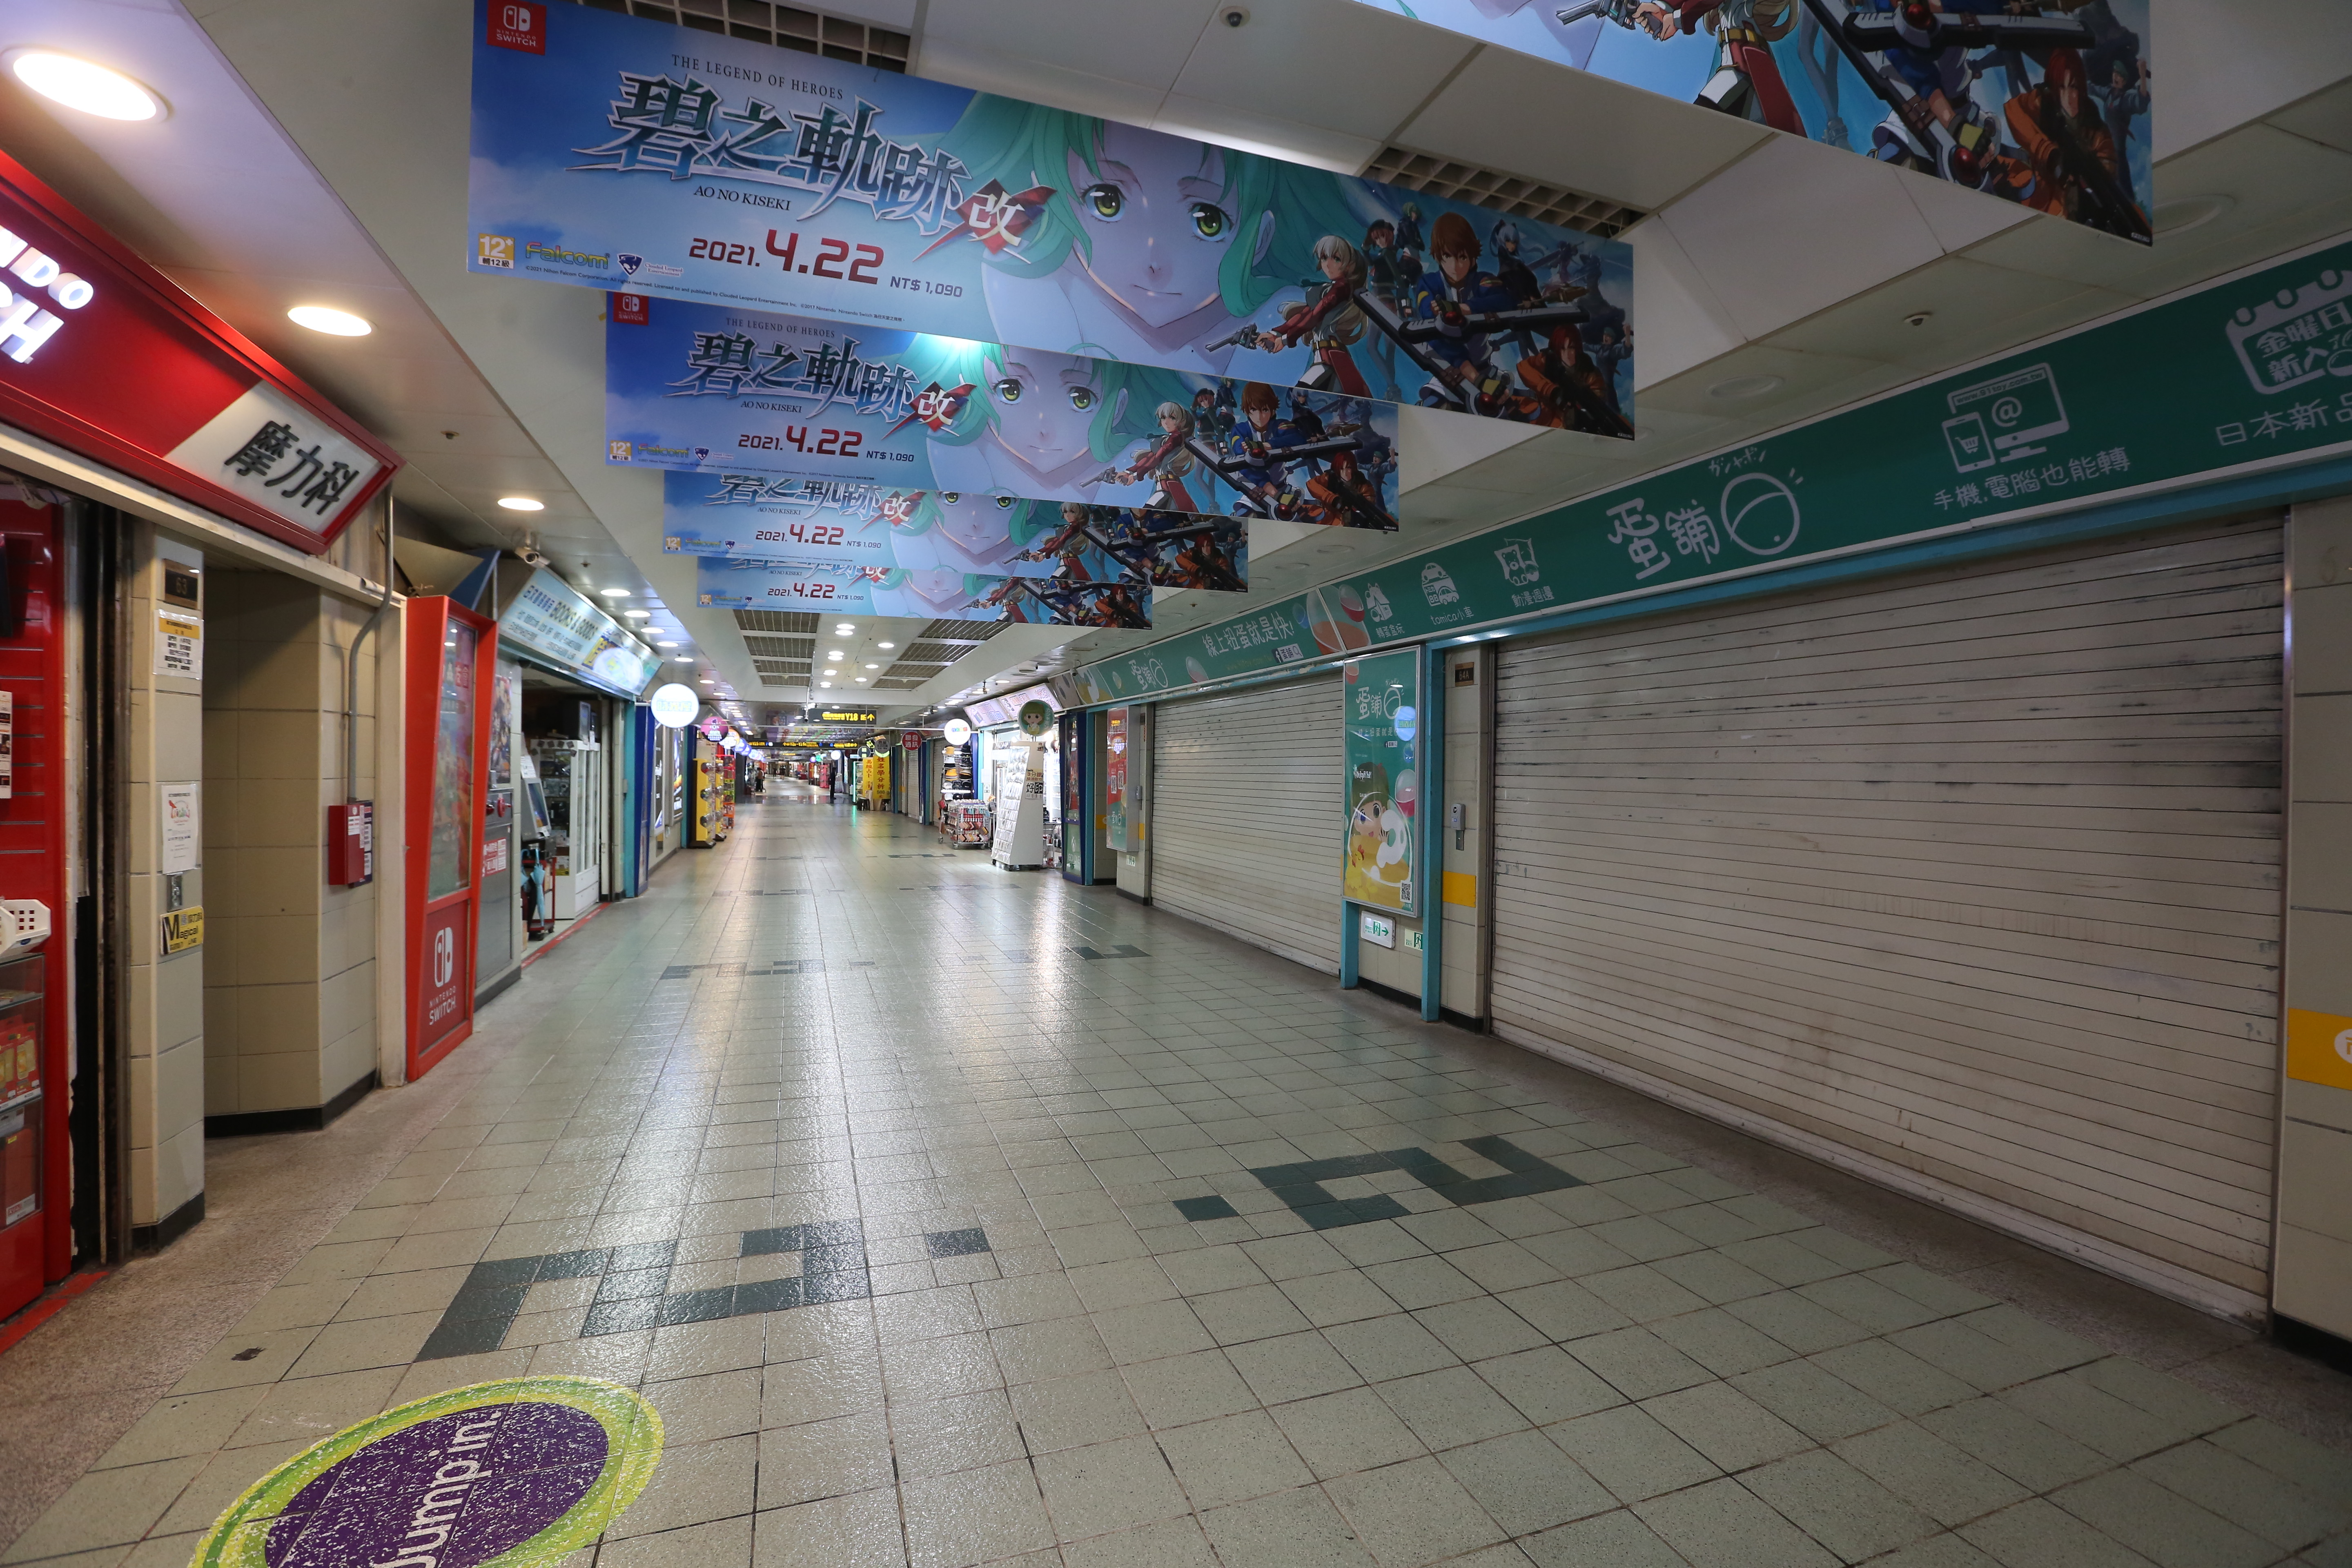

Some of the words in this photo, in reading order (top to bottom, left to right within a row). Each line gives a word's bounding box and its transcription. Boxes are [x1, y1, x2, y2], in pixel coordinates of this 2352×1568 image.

[497, 29, 536, 40] NINTENDO
[497, 33, 536, 47] SWITCH
[672, 54, 699, 70] THE
[706, 61, 762, 82] LEGEND
[768, 74, 785, 87] OF
[791, 78, 843, 100] HEROES
[693, 185, 717, 198] AO
[717, 188, 739, 202] NO
[741, 192, 791, 212] KISEKI
[967, 189, 1027, 247] 改
[480, 235, 513, 258] 12+
[690, 288, 712, 296] published
[739, 294, 757, 303] Leopard
[758, 297, 788, 306] Entertainment
[890, 276, 920, 291] NT$
[925, 281, 963, 298] 1,090
[726, 317, 743, 326] THE
[747, 318, 781, 331] LEGEND
[786, 323, 798, 332] OF
[801, 325, 835, 339] HEROES
[741, 400, 756, 409] AO
[757, 401, 770, 411] NO
[771, 403, 802, 413] KISEKI
[916, 388, 956, 427] 改
[866, 450, 886, 460] NT$
[889, 452, 914, 463] 1,090
[224, 420, 359, 516] 摩力科
[882, 497, 909, 522] 改
[176, 577, 187, 595] 63
[1511, 586, 1555, 608] 動漫週邊
[1202, 611, 1295, 657] 線上扭蛋就是快!
[1459, 670, 1469, 680] 64A
[1356, 686, 1382, 720] 蛋舖
[845, 713, 858, 721] Y18
[1026, 782, 1044, 794] 好印
[429, 985, 457, 1009] NINTENDO
[429, 996, 457, 1025] SWITCH
